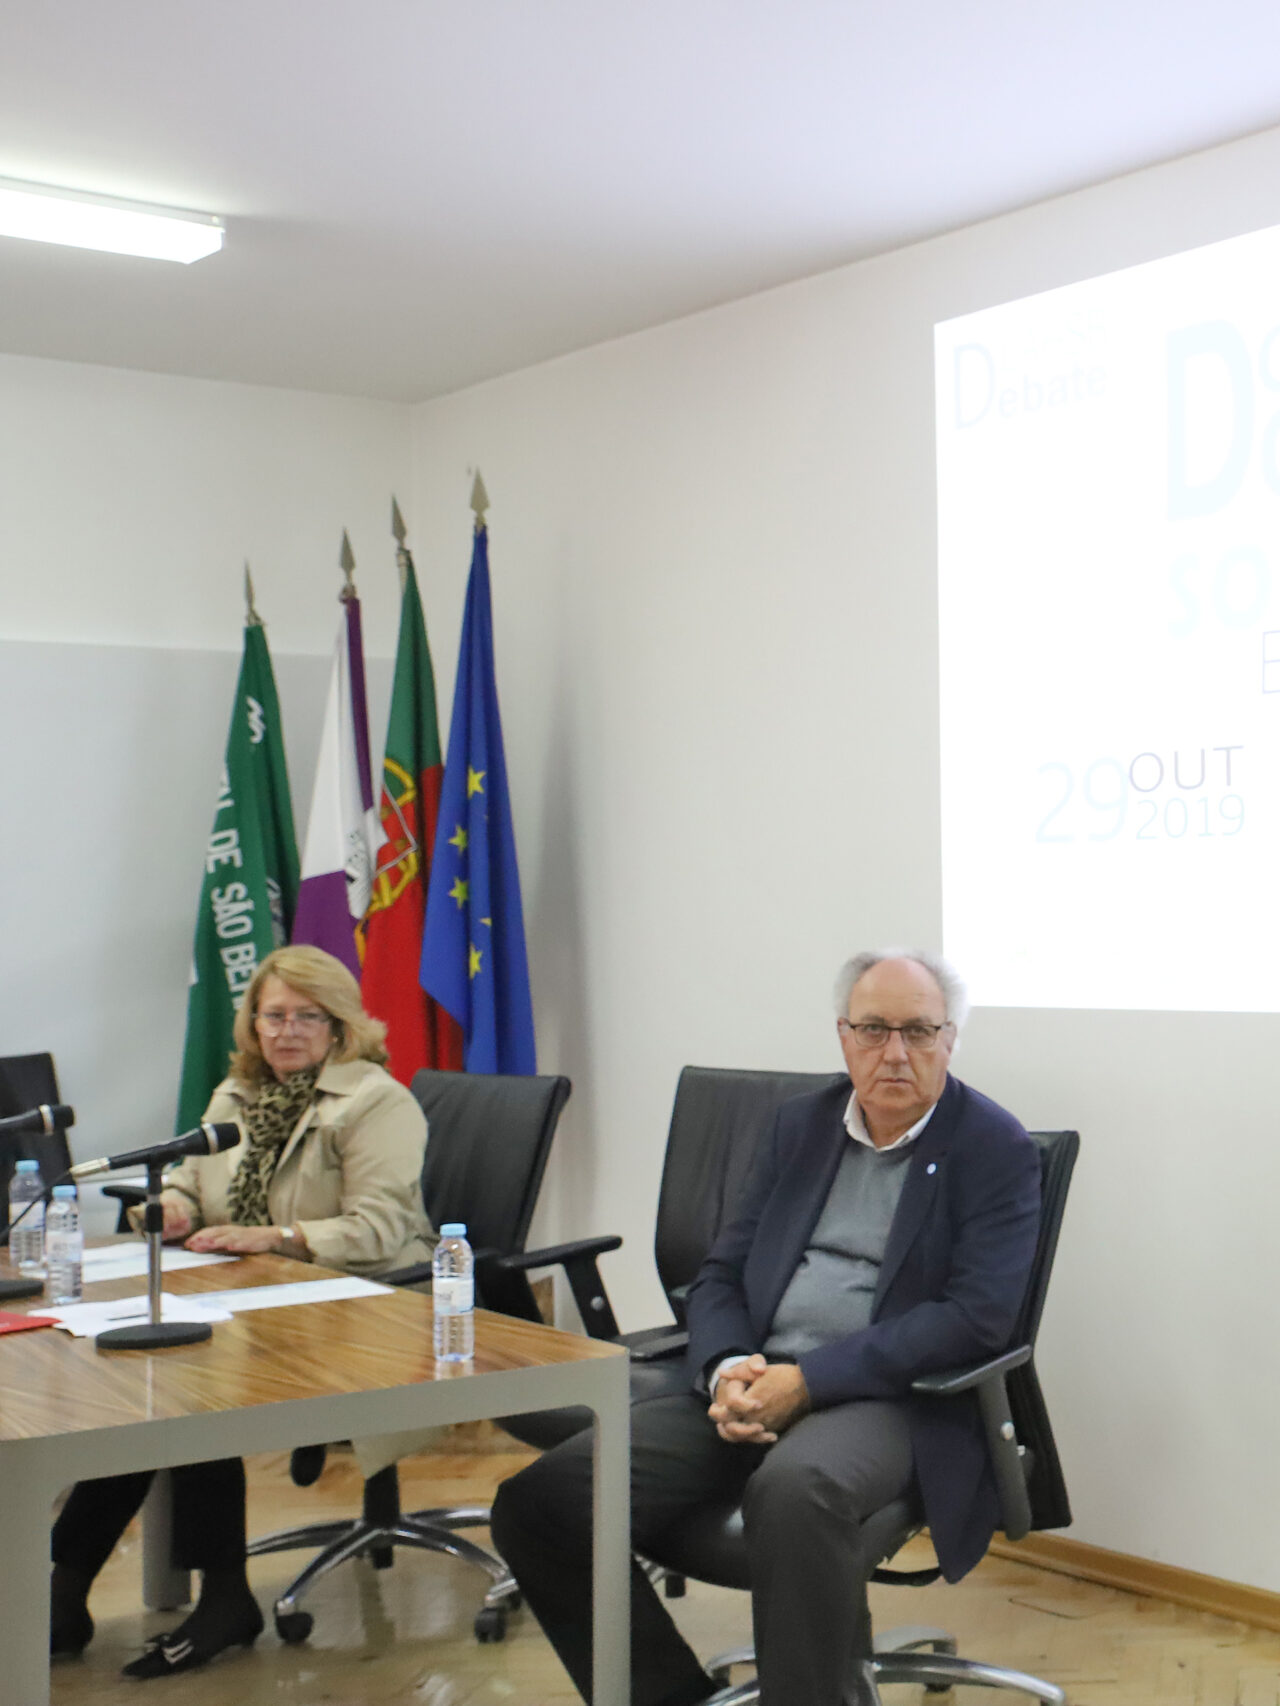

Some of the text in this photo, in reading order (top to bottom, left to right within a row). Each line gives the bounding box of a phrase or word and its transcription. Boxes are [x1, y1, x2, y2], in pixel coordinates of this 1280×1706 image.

[953, 341, 1106, 430] Debate
[1128, 745, 1244, 792] OUT
[1035, 757, 1128, 843] 29
[1135, 794, 1245, 840] 2019
[206, 828, 243, 874] DE
[211, 882, 255, 940] SÃO
